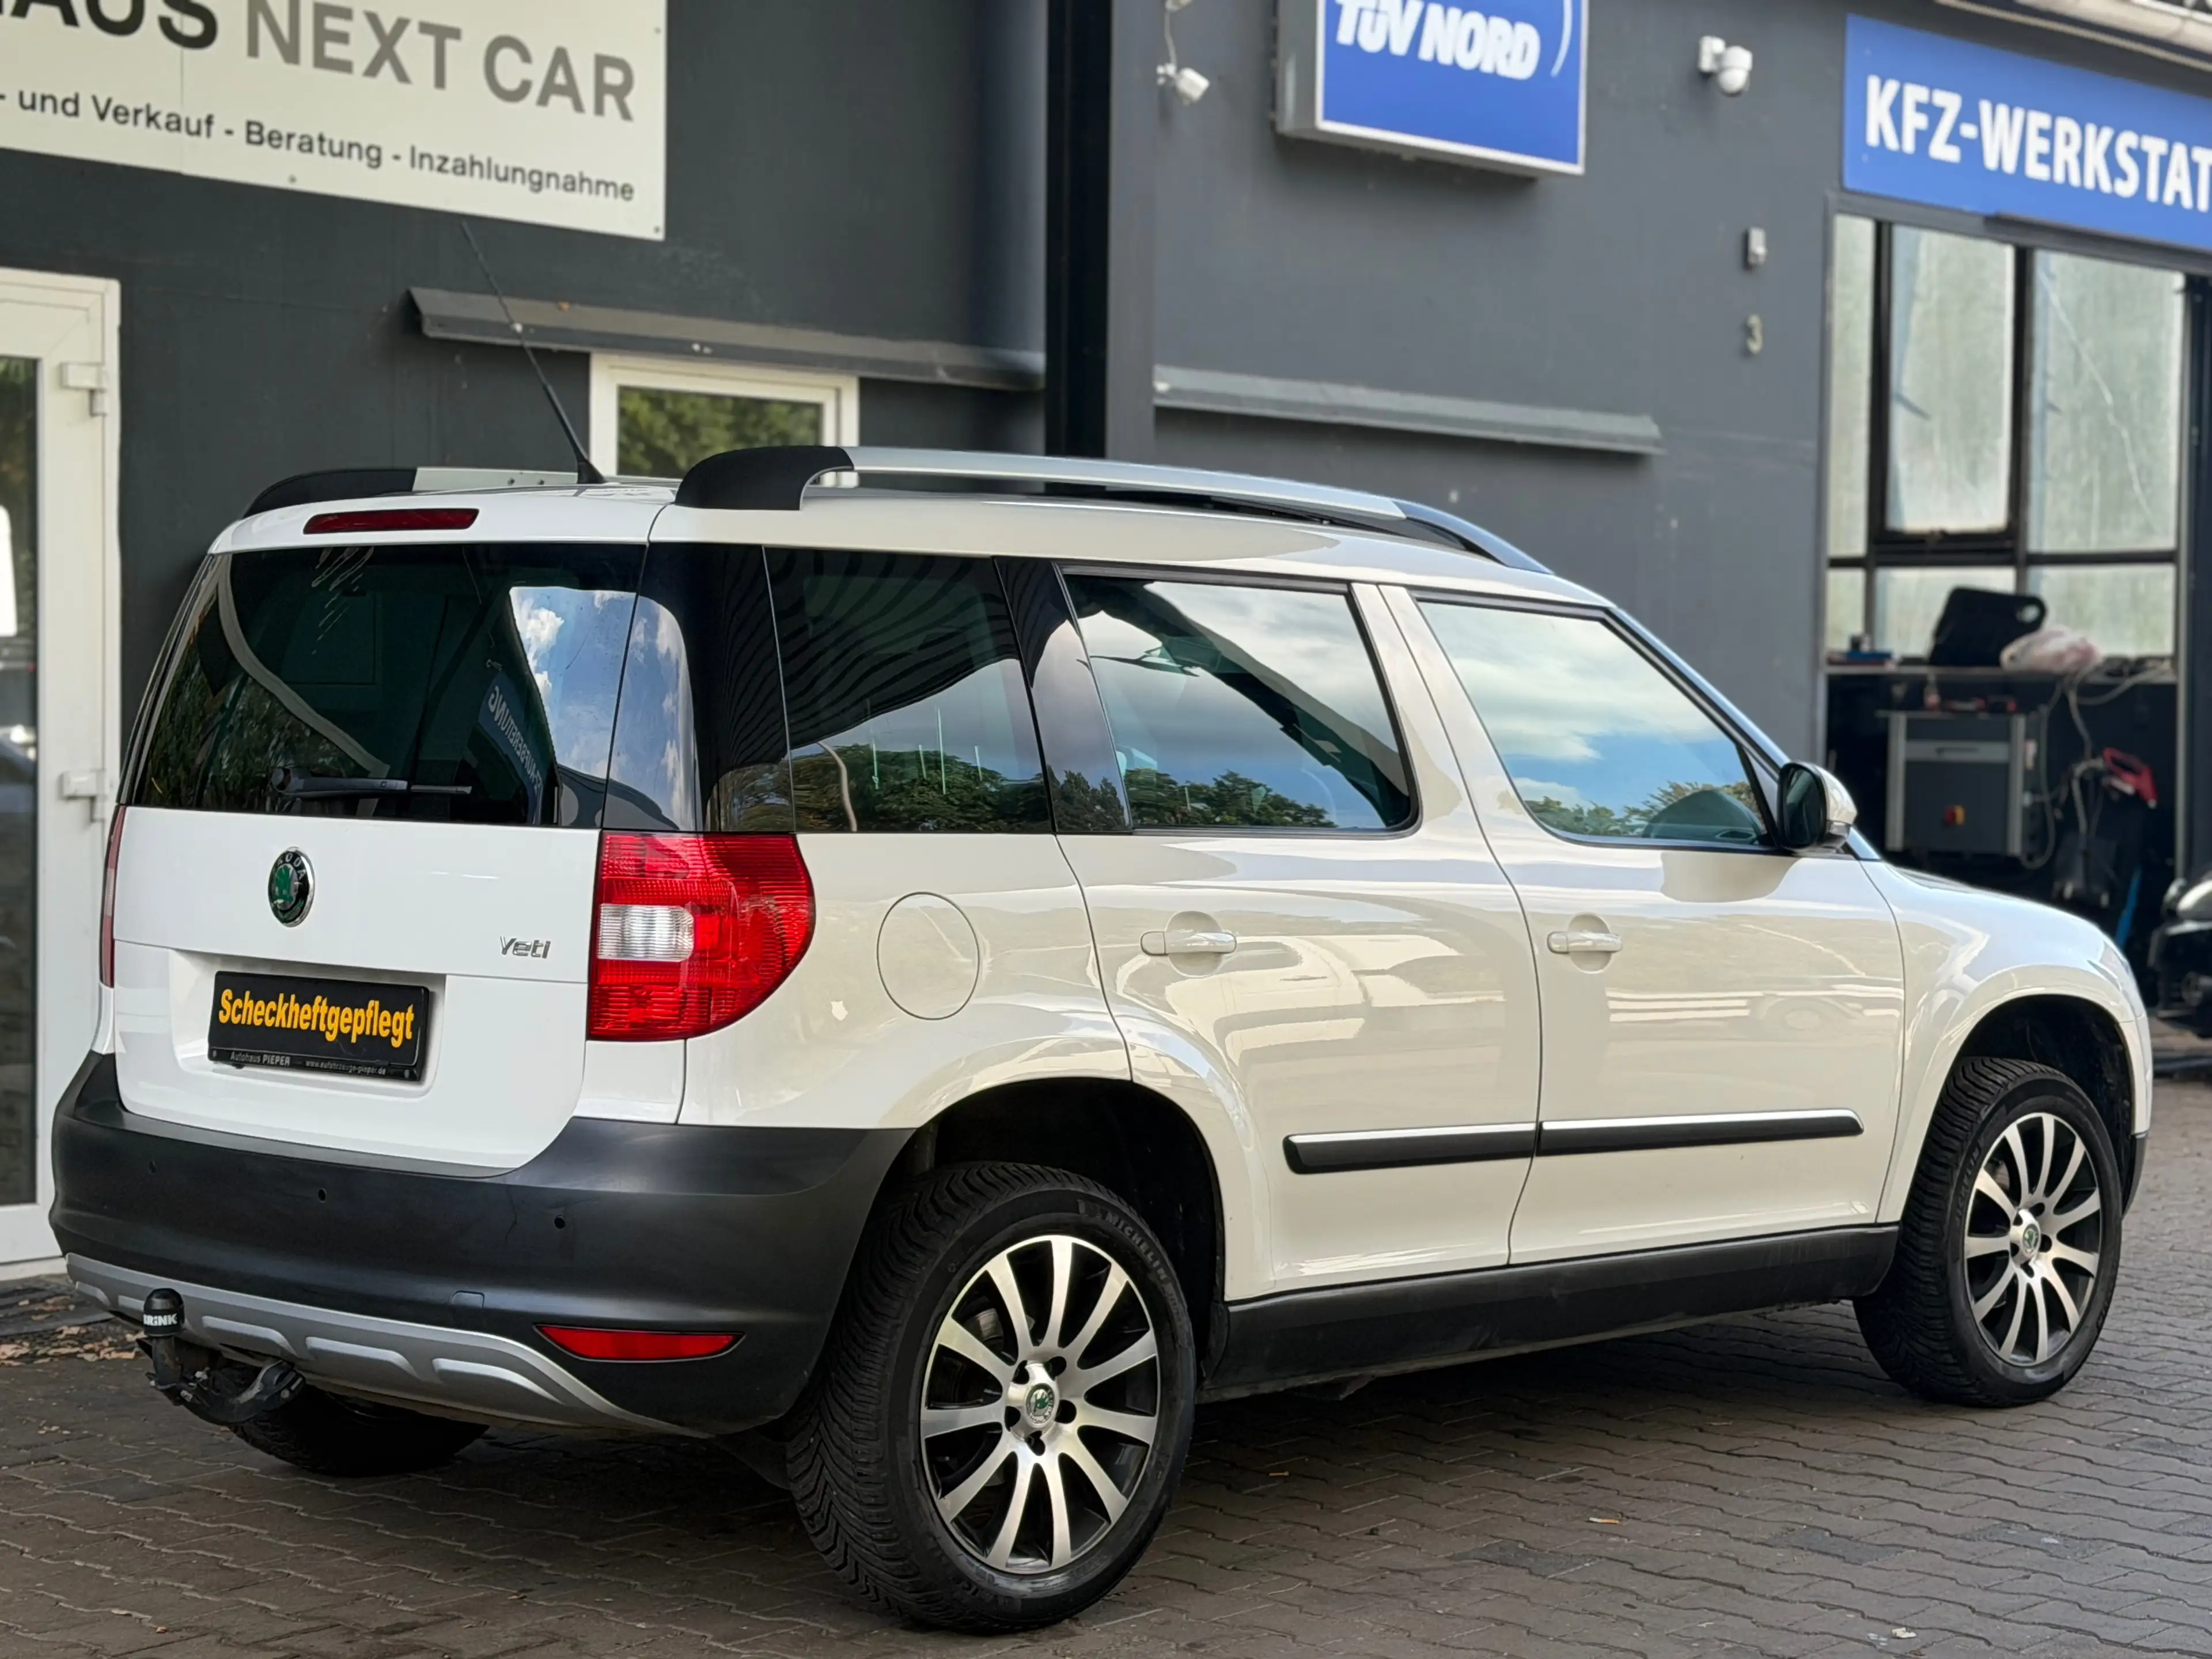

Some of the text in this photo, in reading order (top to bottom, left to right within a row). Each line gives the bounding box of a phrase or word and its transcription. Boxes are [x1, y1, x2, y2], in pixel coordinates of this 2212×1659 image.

[247, 0, 461, 90] NEXT
[483, 35, 635, 123] CAR
[1417, 2, 1541, 80] NORD
[18, 90, 79, 118] und
[91, 94, 215, 138] Verkauf
[245, 120, 382, 169] Beratung
[410, 145, 634, 202] Inzahlungnahme
[1746, 314, 1763, 355] 3
[218, 988, 415, 1048] Scheckheftgepflegt
[262, 1054, 291, 1067] PIEPER
[1104, 1210, 1169, 1281] MICHELIN
